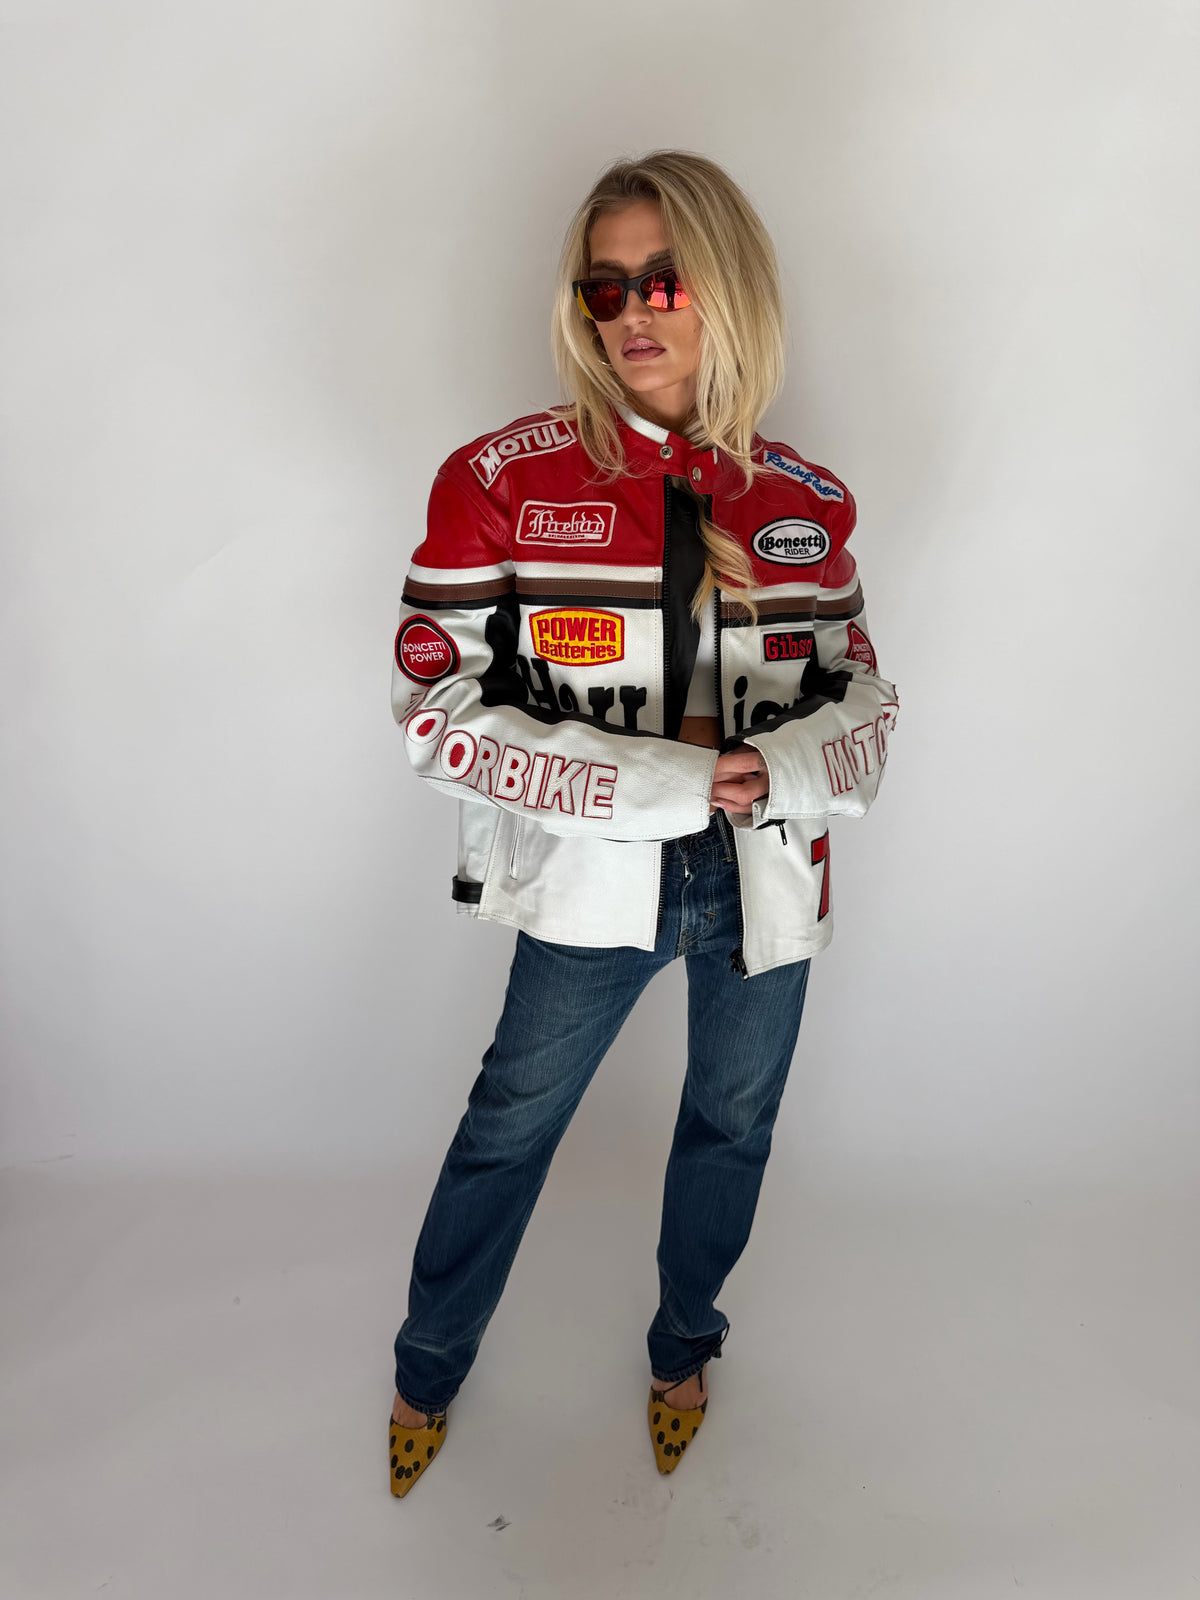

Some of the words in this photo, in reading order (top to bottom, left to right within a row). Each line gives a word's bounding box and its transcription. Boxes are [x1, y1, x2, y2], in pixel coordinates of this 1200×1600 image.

[479, 424, 570, 482] MOTUL
[765, 451, 813, 483] Racing
[763, 534, 823, 550] Boncetti
[784, 547, 811, 556] RIDER
[537, 617, 617, 642] POWER
[403, 641, 446, 653] BONCETTI
[540, 640, 617, 659] Batteries
[410, 651, 445, 664] POWER
[811, 828, 830, 922] 7
